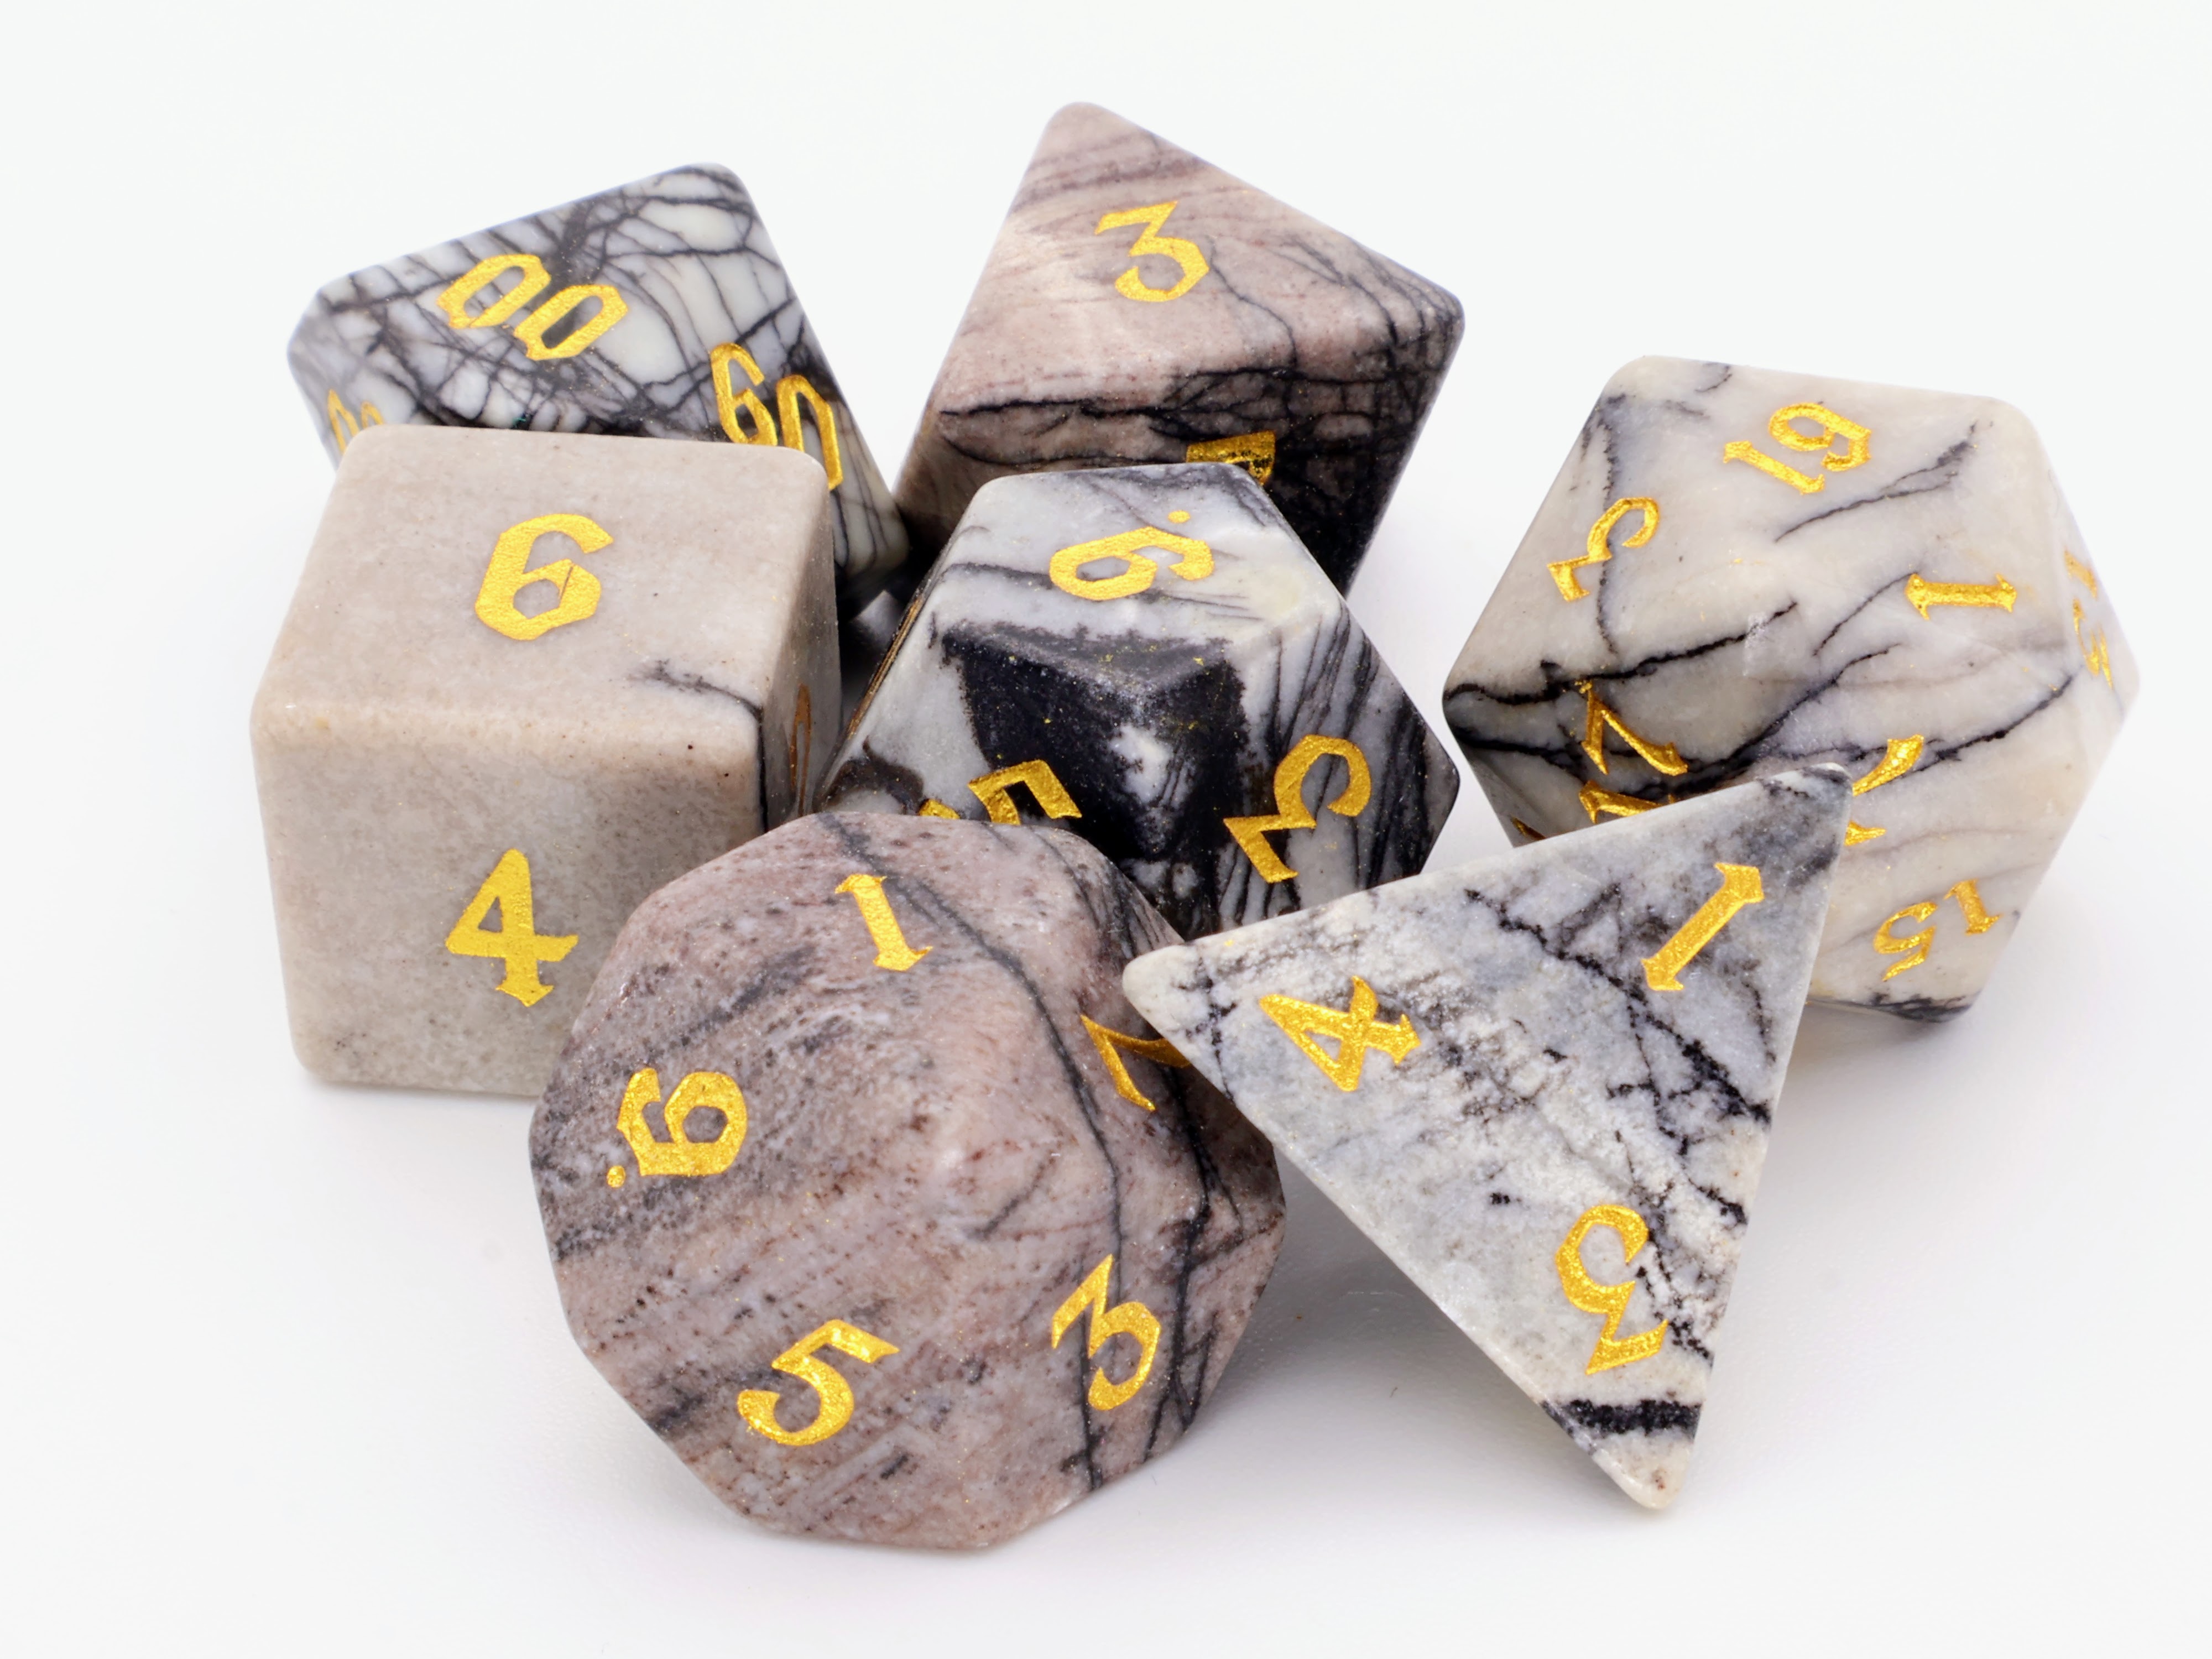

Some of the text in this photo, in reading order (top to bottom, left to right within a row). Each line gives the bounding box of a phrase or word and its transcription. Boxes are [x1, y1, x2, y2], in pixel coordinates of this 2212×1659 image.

[438, 253, 628, 359] 00
[1095, 201, 1209, 301] 3
[1724, 403, 1872, 494] 19
[475, 514, 613, 640] 6
[1548, 497, 1661, 602] 3
[1905, 573, 2017, 619] 1
[1223, 733, 1373, 885] 3
[445, 848, 579, 1007] 4
[836, 874, 929, 972] 1
[1642, 863, 1765, 990] 1
[1874, 879, 2000, 981] 15
[1079, 1014, 1192, 1113] 7
[1260, 977, 1421, 1092] 4
[1049, 1256, 1162, 1411] 3
[1555, 1204, 1670, 1375] 3
[736, 1318, 900, 1448] 5
